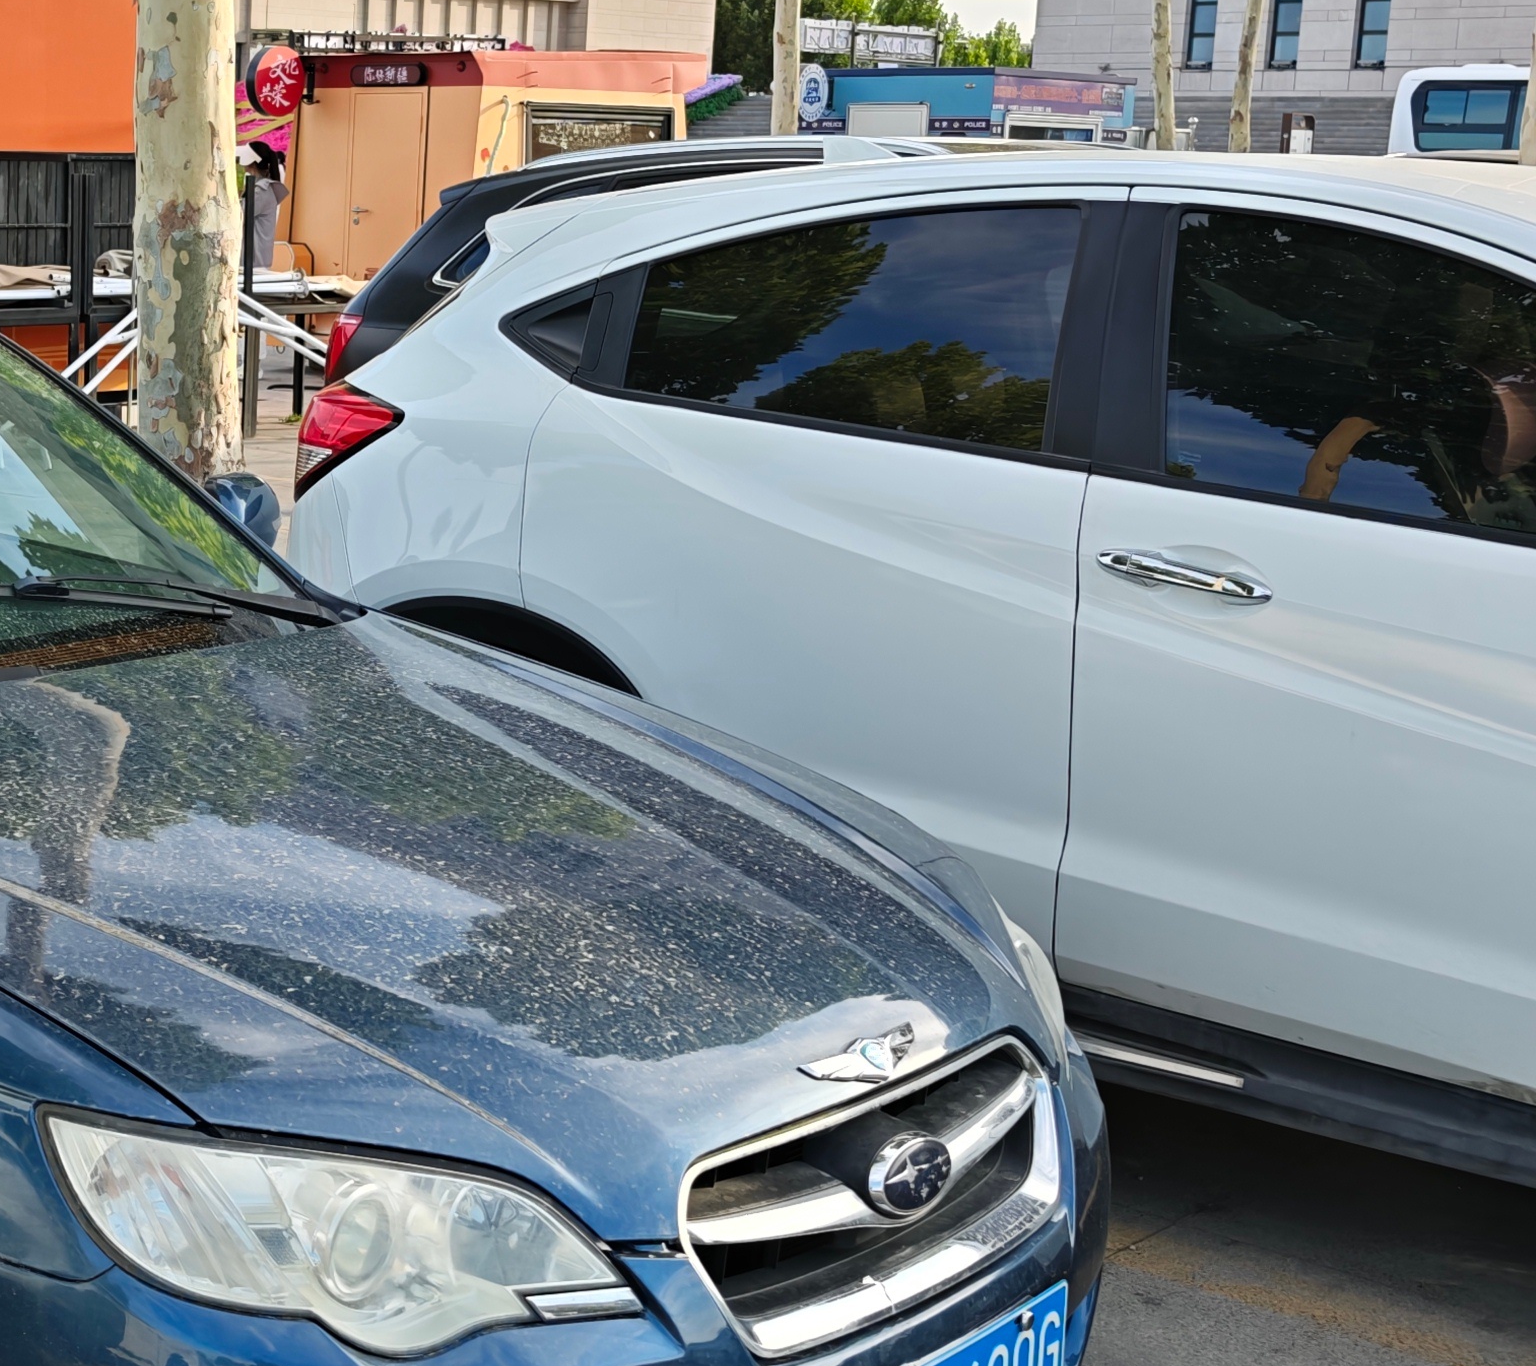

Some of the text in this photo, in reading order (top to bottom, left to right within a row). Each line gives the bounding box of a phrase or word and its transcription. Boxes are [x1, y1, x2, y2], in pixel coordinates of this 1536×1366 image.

[269, 55, 300, 85] 文化
[364, 66, 409, 84] 你好新疆
